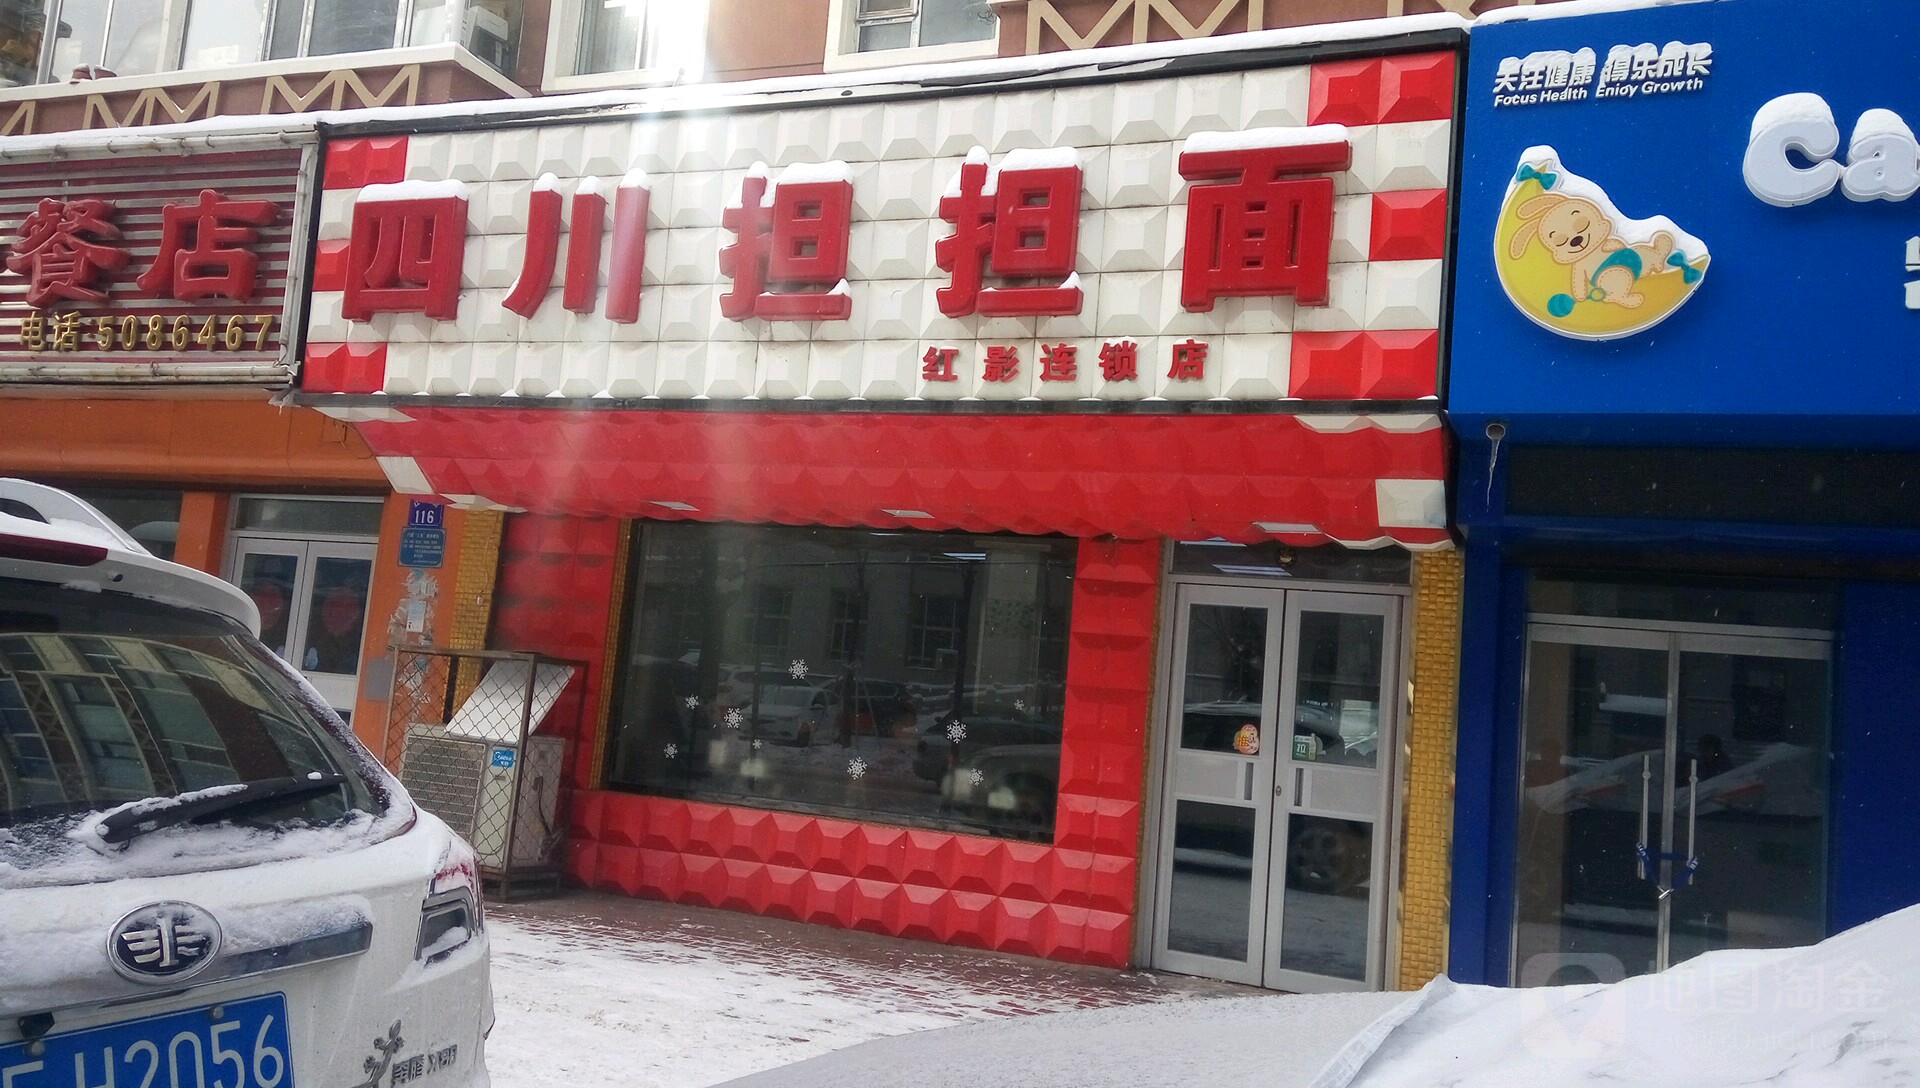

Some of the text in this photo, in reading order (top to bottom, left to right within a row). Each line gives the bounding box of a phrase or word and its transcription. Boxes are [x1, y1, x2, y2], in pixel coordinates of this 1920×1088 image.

[1494, 93, 1537, 108] Focus
[1540, 87, 1588, 103] Health
[1641, 78, 1703, 95] Growth
[5, 188, 282, 306] 餐店
[341, 140, 1352, 322] 四川担担面
[922, 338, 1209, 382] 红影连锁店
[415, 510, 434, 524] 116
